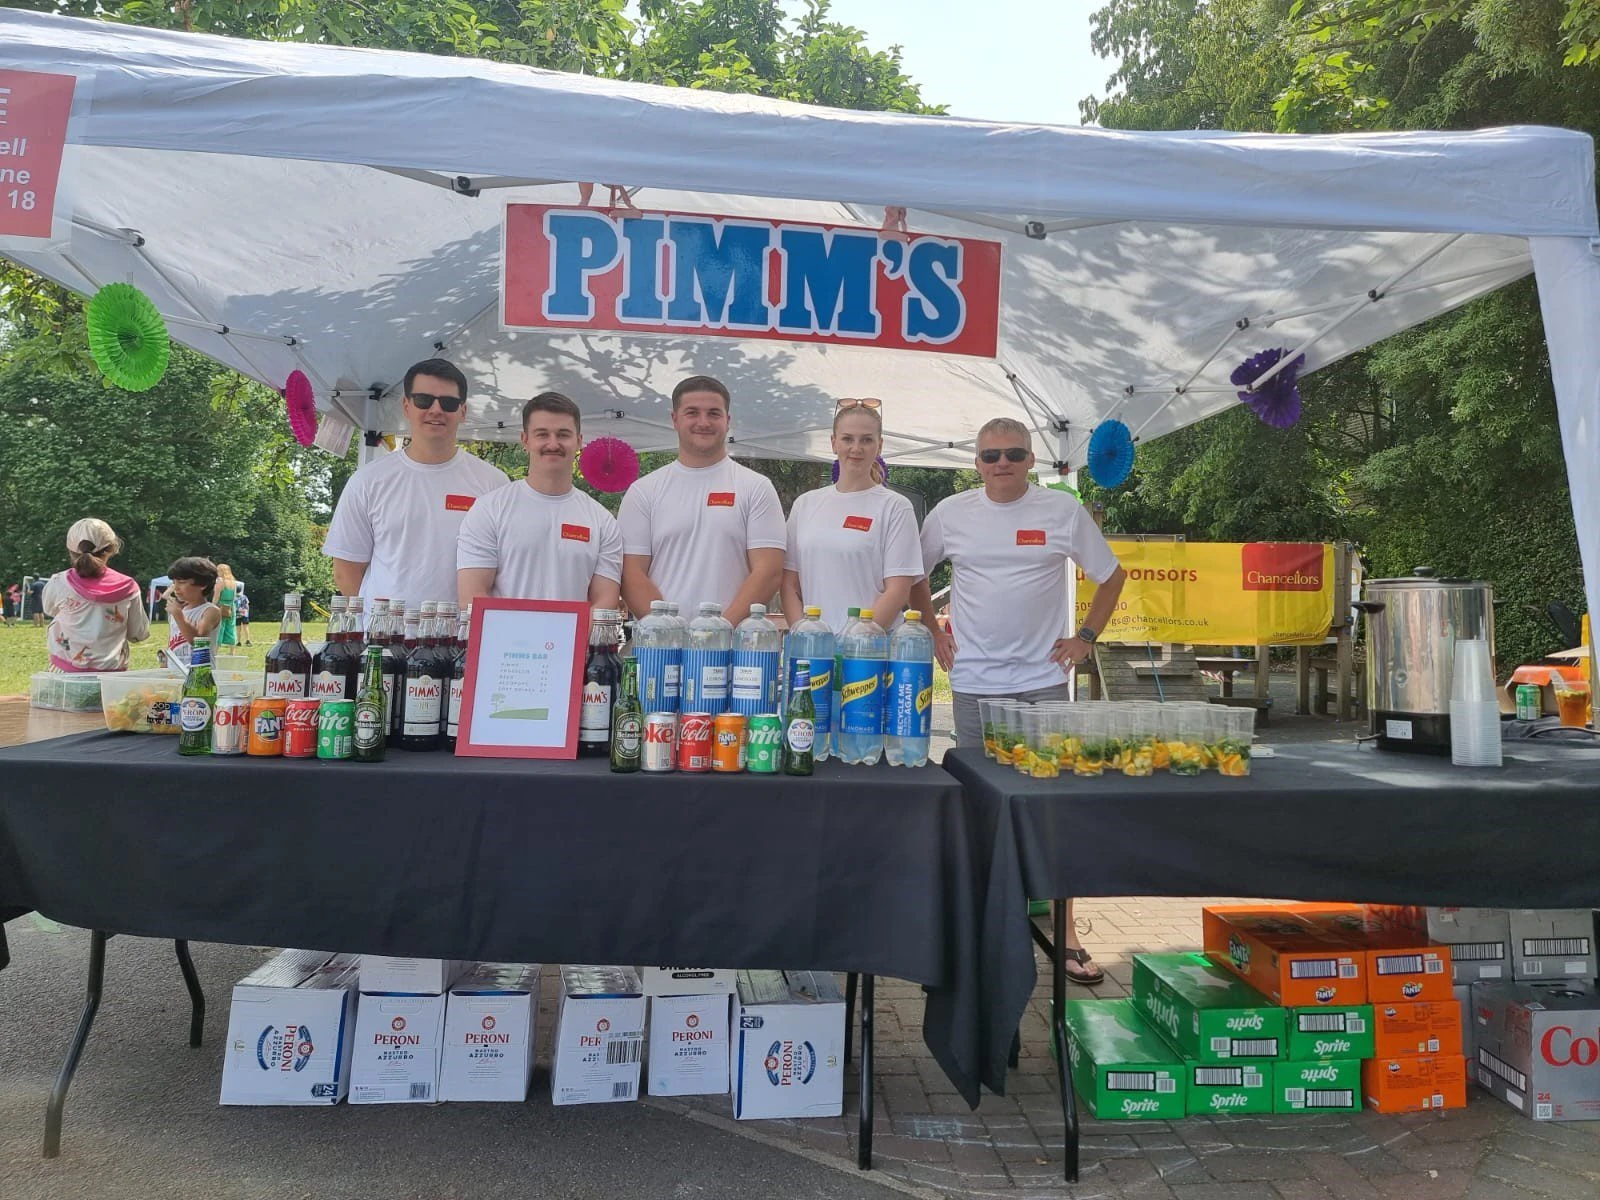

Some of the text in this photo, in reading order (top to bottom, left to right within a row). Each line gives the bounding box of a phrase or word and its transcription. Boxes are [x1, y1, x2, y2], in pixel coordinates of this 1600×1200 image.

[8, 190, 36, 210] 18
[542, 209, 967, 344] PIMM'S
[1247, 570, 1319, 585] Chancellors
[268, 680, 302, 693] PIMM'S
[312, 680, 342, 694] PIMM'S
[408, 685, 440, 697] PIMM'S
[898, 683, 905, 697] ME
[584, 691, 607, 704] IMM'S
[904, 683, 913, 715] AGAIN
[255, 716, 284, 733] FANT
[1146, 992, 1180, 1038] Sprite
[1226, 1014, 1264, 1031] Sprite
[374, 1033, 420, 1045] PERONI
[465, 1033, 510, 1044] PERONI
[580, 1035, 601, 1047] PER
[672, 1030, 713, 1041] PERONI
[281, 1025, 298, 1072] PERONI
[1313, 1039, 1350, 1054] Sprite
[1540, 1025, 1600, 1067] Co
[781, 1040, 793, 1086] PERONI
[1301, 1066, 1339, 1082] Sprite
[323, 1084, 335, 1096] 24
[1120, 1098, 1160, 1114] Sprite
[1209, 1093, 1248, 1109] Sprite
